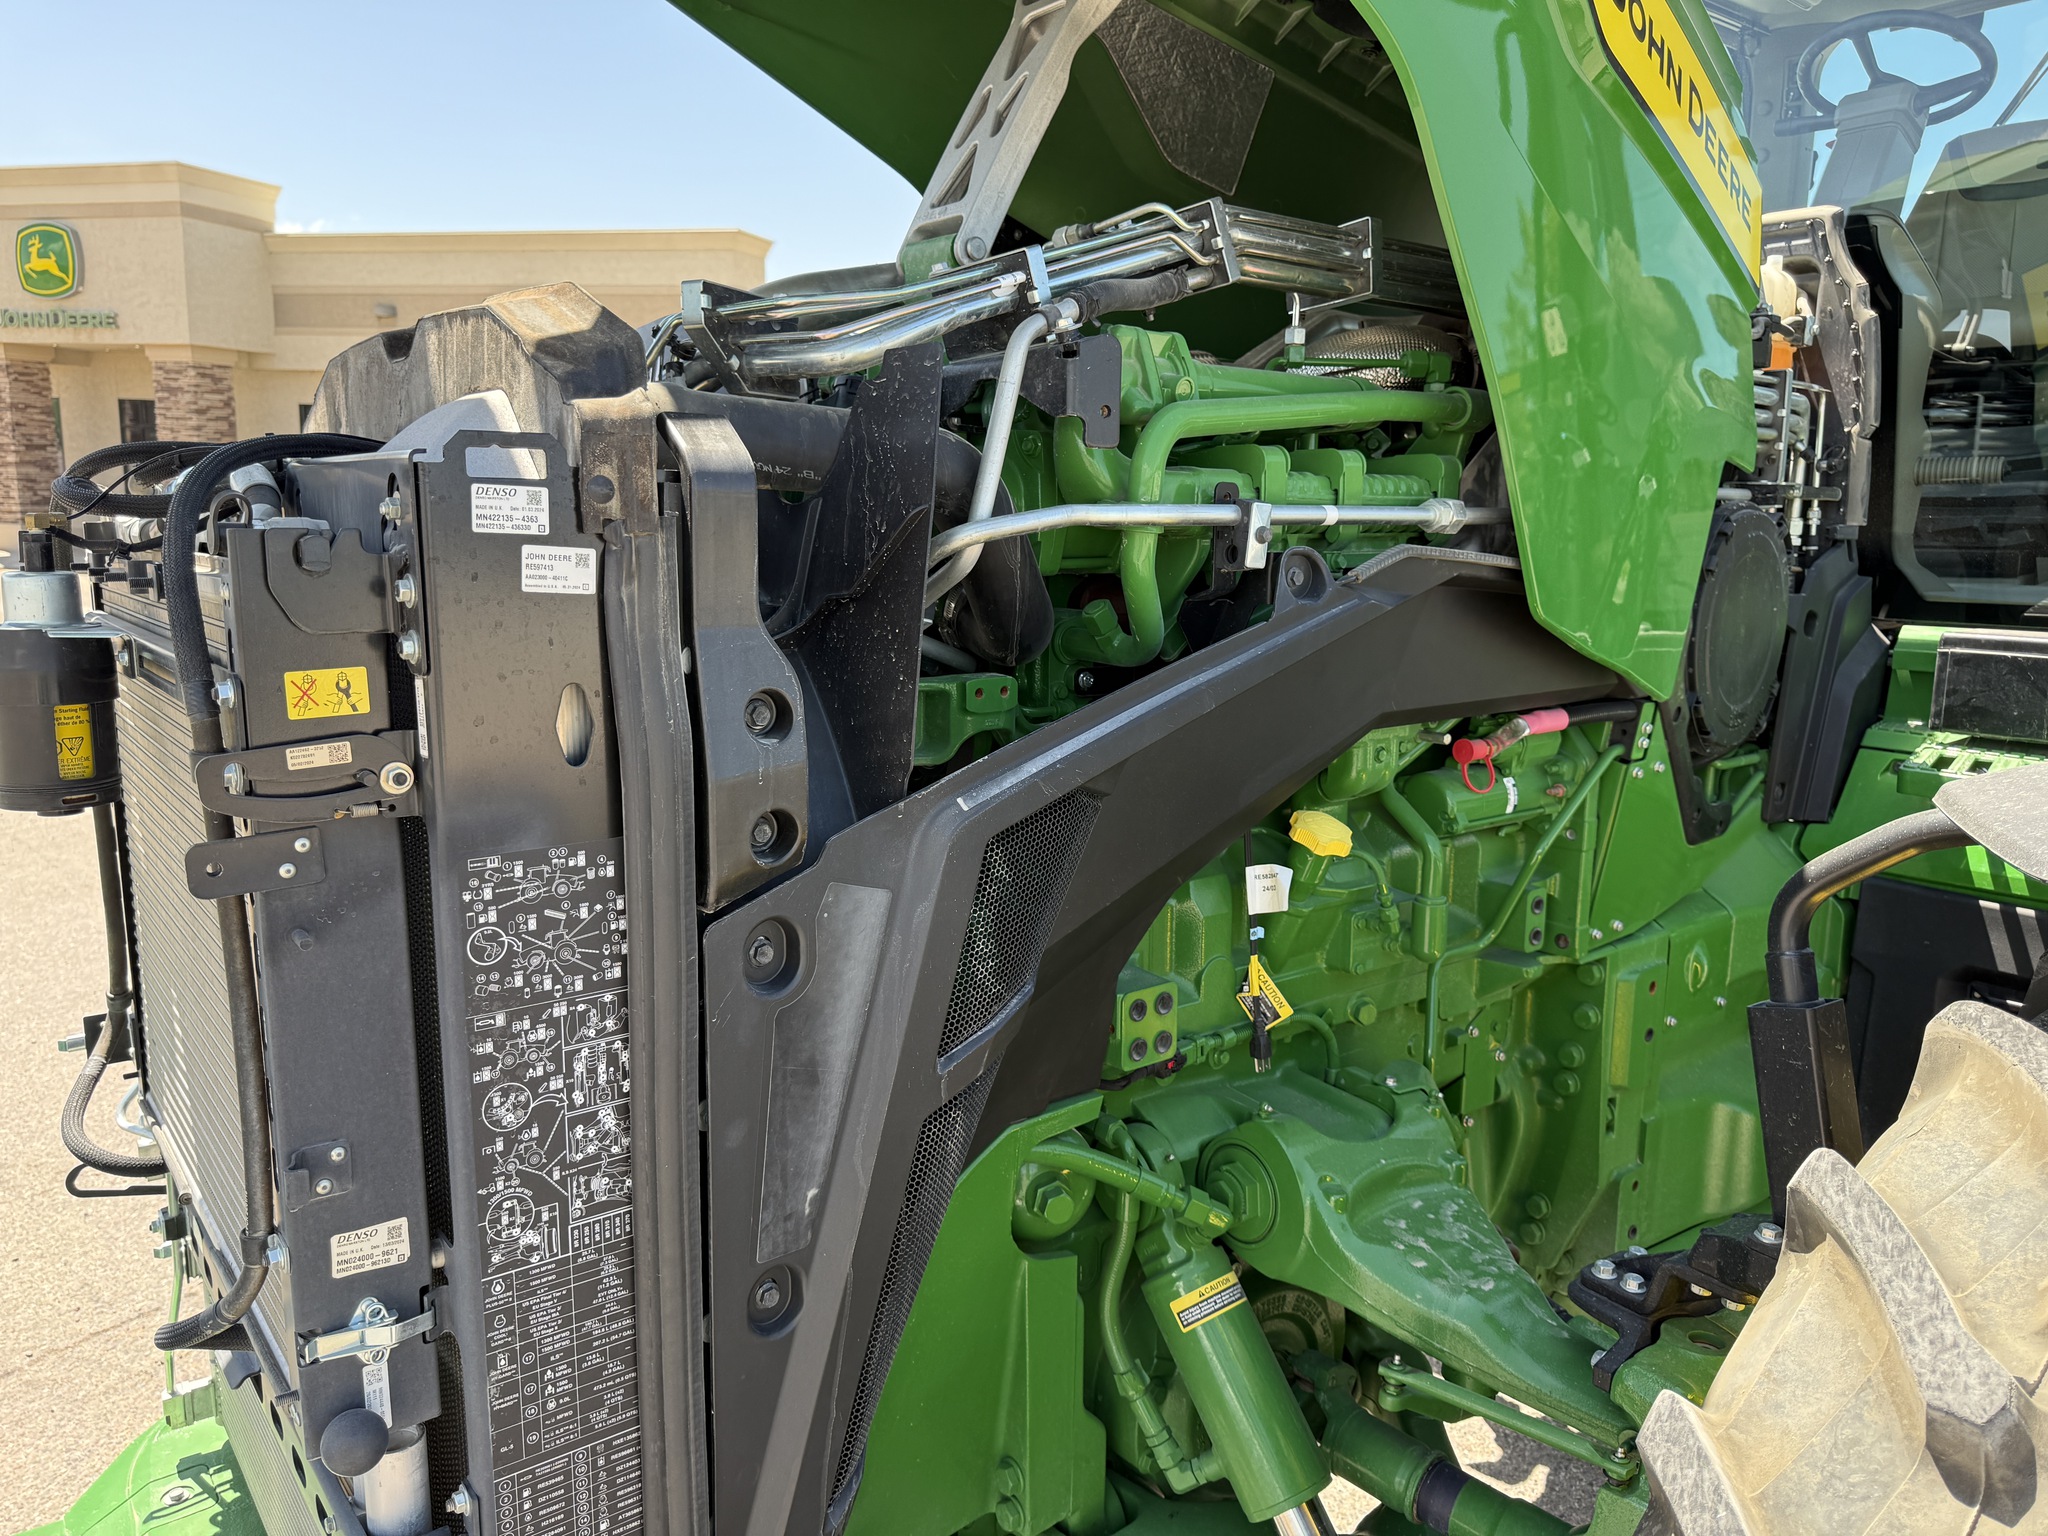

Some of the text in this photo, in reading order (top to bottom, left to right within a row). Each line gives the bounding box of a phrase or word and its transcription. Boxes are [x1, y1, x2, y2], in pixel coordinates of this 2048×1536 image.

[1687, 75, 1752, 234] DEERE
[50, 309, 118, 328] DEERE
[476, 487, 517, 497] DENSO
[525, 552, 572, 562] JOHN DEERE
[525, 563, 554, 571] RE597413
[1258, 974, 1285, 1009] CAUTION
[488, 1187, 533, 1205] 1300/1500 MFWD
[337, 1228, 378, 1244] DENSO
[610, 1278, 623, 1286] GAL)
[1204, 1277, 1231, 1294] CAUTION
[497, 1291, 512, 1299] DEERE
[539, 1315, 551, 1323] Stage
[500, 1325, 514, 1333] DEERE
[541, 1328, 554, 1336] Stage
[554, 1331, 570, 1340] MFWD
[554, 1340, 571, 1348] MFWD
[592, 1356, 605, 1364] GAL)
[502, 1364, 517, 1372] DEERE
[613, 1364, 625, 1372] GAL)
[555, 1368, 572, 1377] MFWD
[556, 1384, 573, 1392] MFWD
[556, 1410, 573, 1420] MFWD
